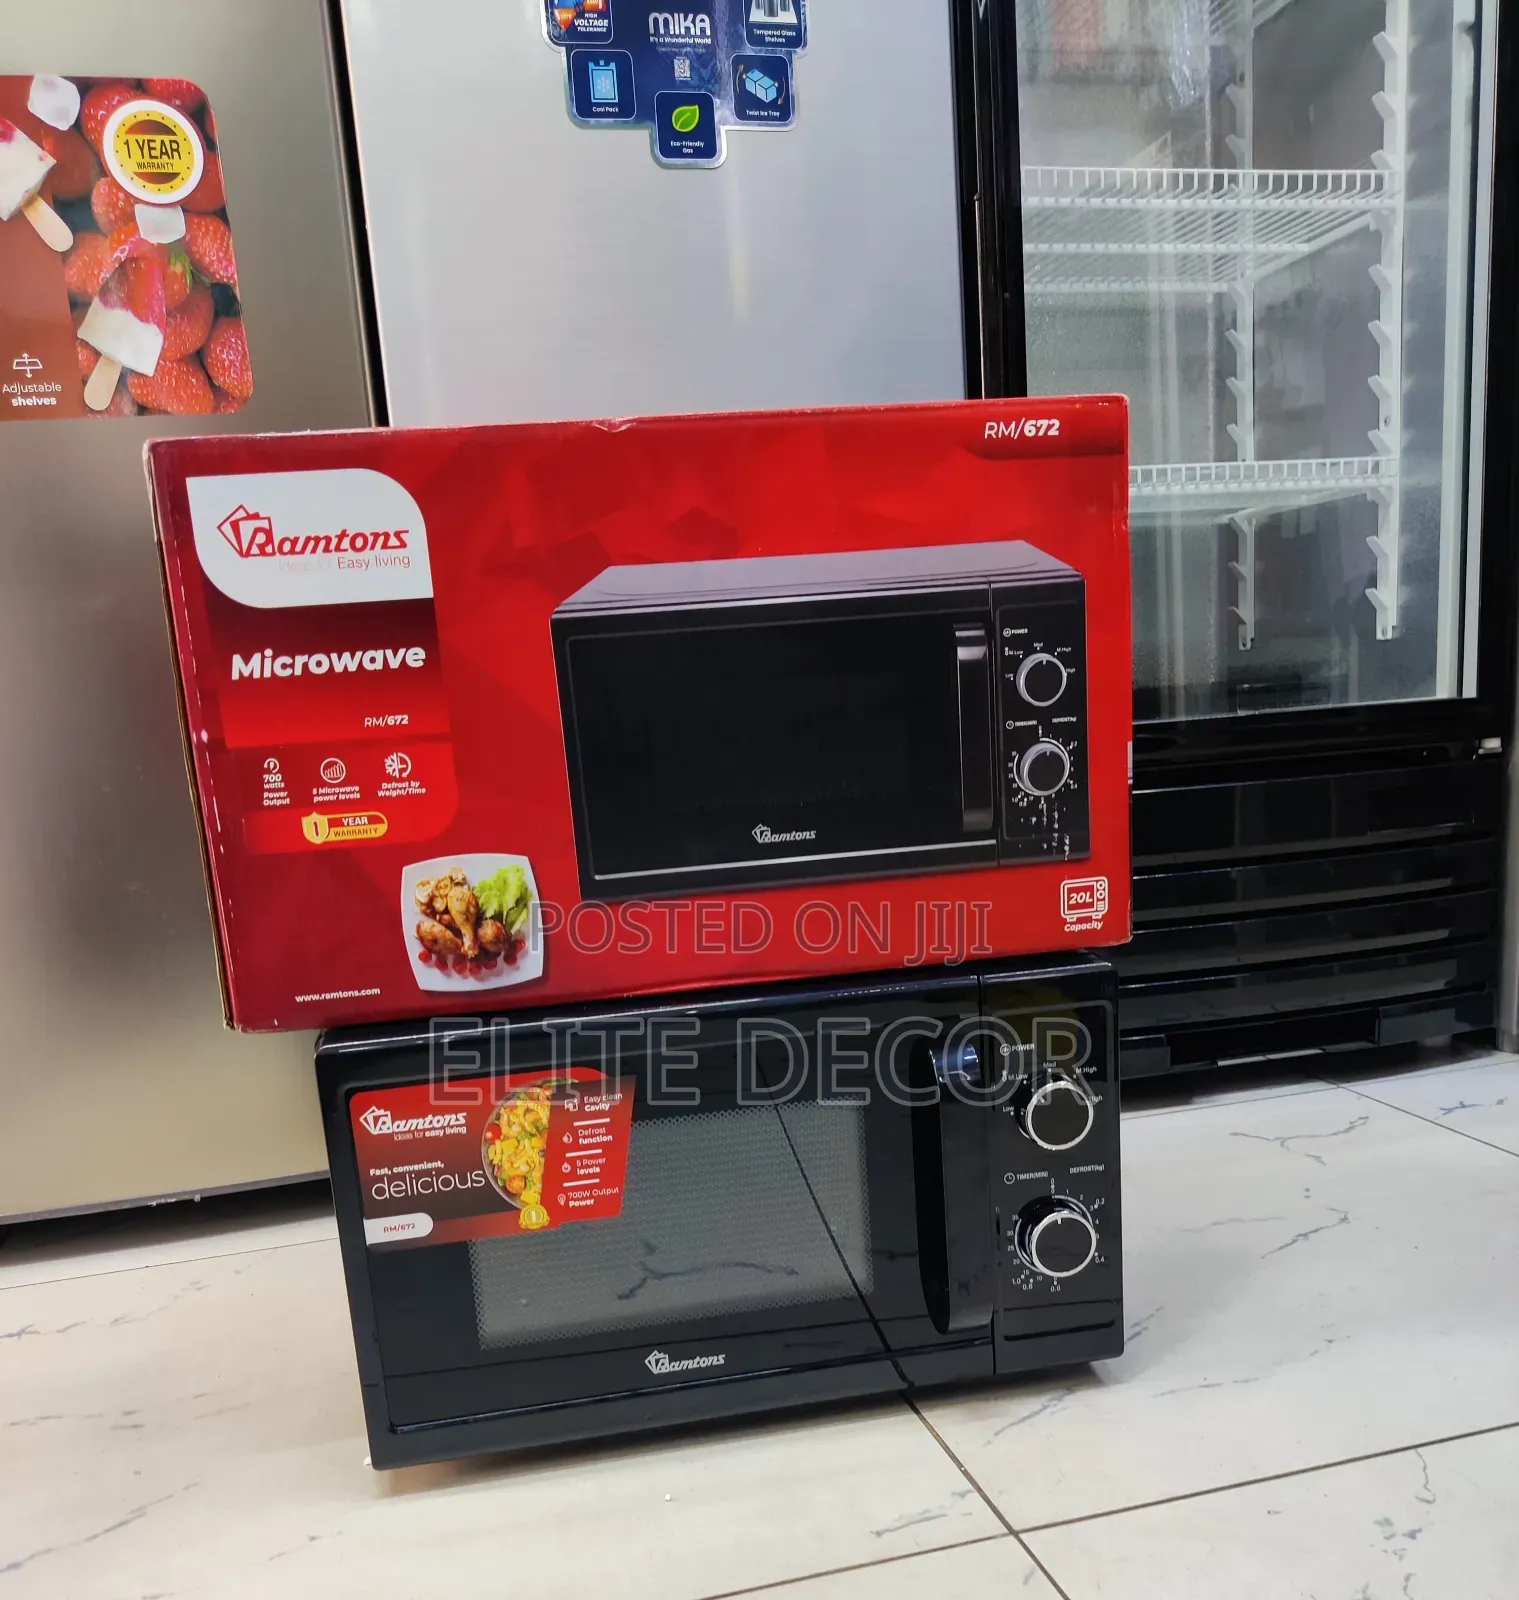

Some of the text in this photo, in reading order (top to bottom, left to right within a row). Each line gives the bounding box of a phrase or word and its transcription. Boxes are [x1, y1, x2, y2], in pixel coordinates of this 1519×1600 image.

[574, 19, 609, 27] VOLTAGE
[648, 12, 711, 36] MIKA
[753, 29, 779, 37] Tempered
[670, 140, 705, 148] Eco-Friendly
[123, 139, 181, 161] 1 YEAR
[136, 160, 175, 171] WARRANTY
[2, 382, 62, 396] Adjustable
[11, 394, 57, 406] shelves
[984, 417, 1060, 440] RM/672
[234, 516, 410, 557] Ramtons
[337, 555, 370, 571] Easy
[374, 553, 411, 569] living
[231, 645, 427, 680] Microwave
[364, 714, 409, 728] RM/672
[263, 773, 282, 783] 700
[318, 785, 360, 794] Microwave
[381, 780, 420, 790] Defrost by
[263, 791, 288, 799] Power
[313, 792, 361, 803] power levels
[377, 787, 427, 798] Weight/Time
[263, 797, 290, 806] Output
[341, 816, 369, 827] YEAR
[312, 821, 319, 837] 1
[333, 827, 379, 838] WARRANTY
[756, 826, 817, 844] Ramtons
[1069, 891, 1093, 905] 20L
[1064, 920, 1104, 932] Capacity
[295, 987, 381, 1003] www.ramtons.com
[1011, 1044, 1035, 1052] POWER
[584, 1093, 623, 1104] Easy clean
[584, 1102, 611, 1112] Cavity
[367, 1110, 467, 1135] Ramtons
[393, 1126, 467, 1141] Ideas for easy living
[578, 1127, 606, 1137] Defrost
[578, 1135, 613, 1145] function
[582, 1158, 606, 1166] Power
[369, 1160, 445, 1177] Fast, convenient,
[577, 1166, 601, 1176] levels
[1069, 1164, 1105, 1174] DEFROST(kg)
[371, 1170, 486, 1200] delicious
[568, 1186, 620, 1199] 700W Output
[568, 1199, 595, 1208] Power
[383, 1222, 417, 1234] RM/672
[1094, 1256, 1105, 1264] 0.4
[649, 1352, 726, 1374] Ramtons
